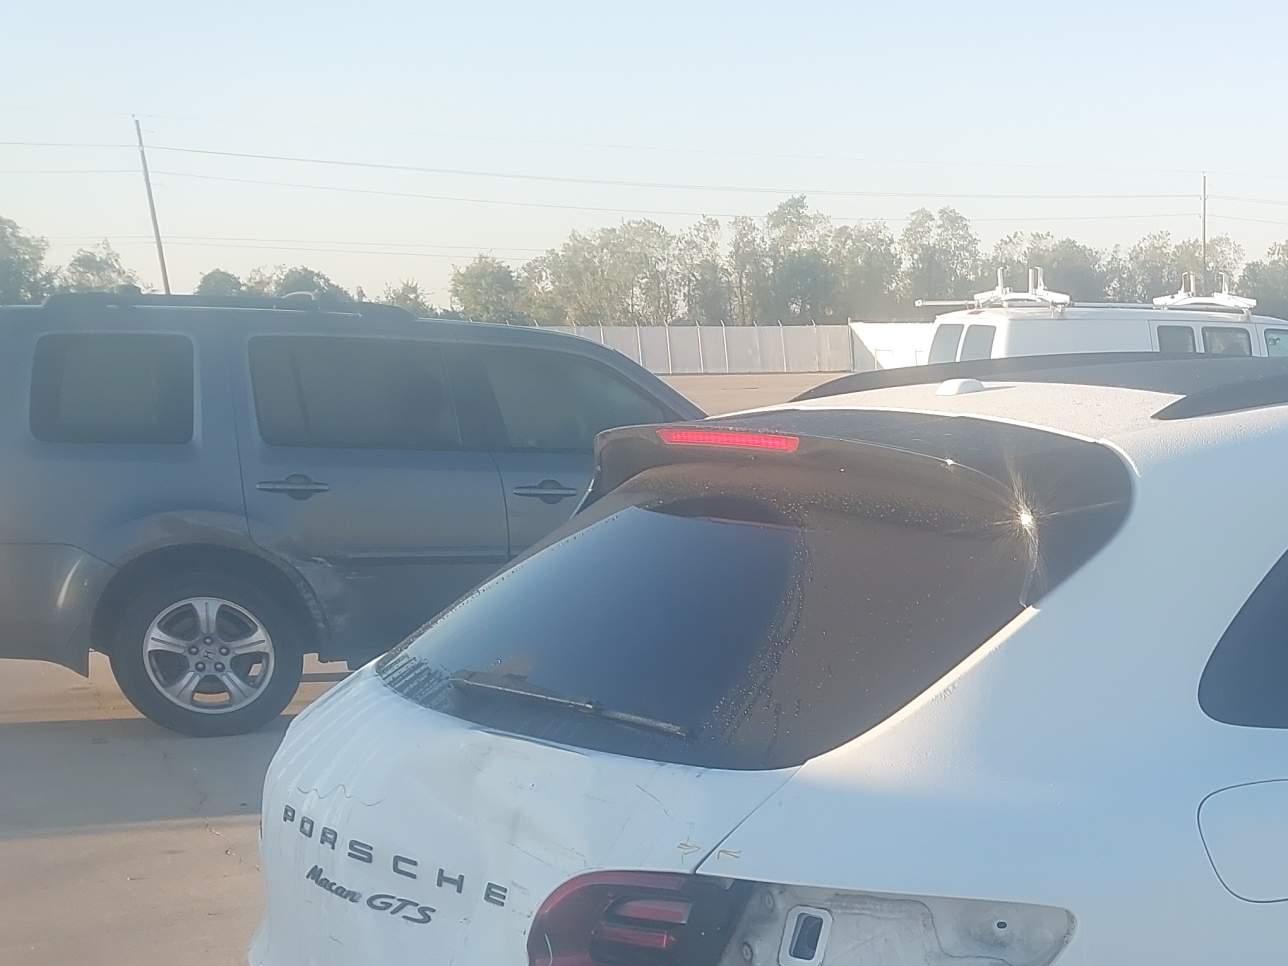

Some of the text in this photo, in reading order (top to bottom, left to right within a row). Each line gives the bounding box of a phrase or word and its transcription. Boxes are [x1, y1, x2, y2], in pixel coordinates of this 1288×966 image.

[283, 804, 508, 907] PORSCHE
[305, 864, 437, 924] Macan GTS
